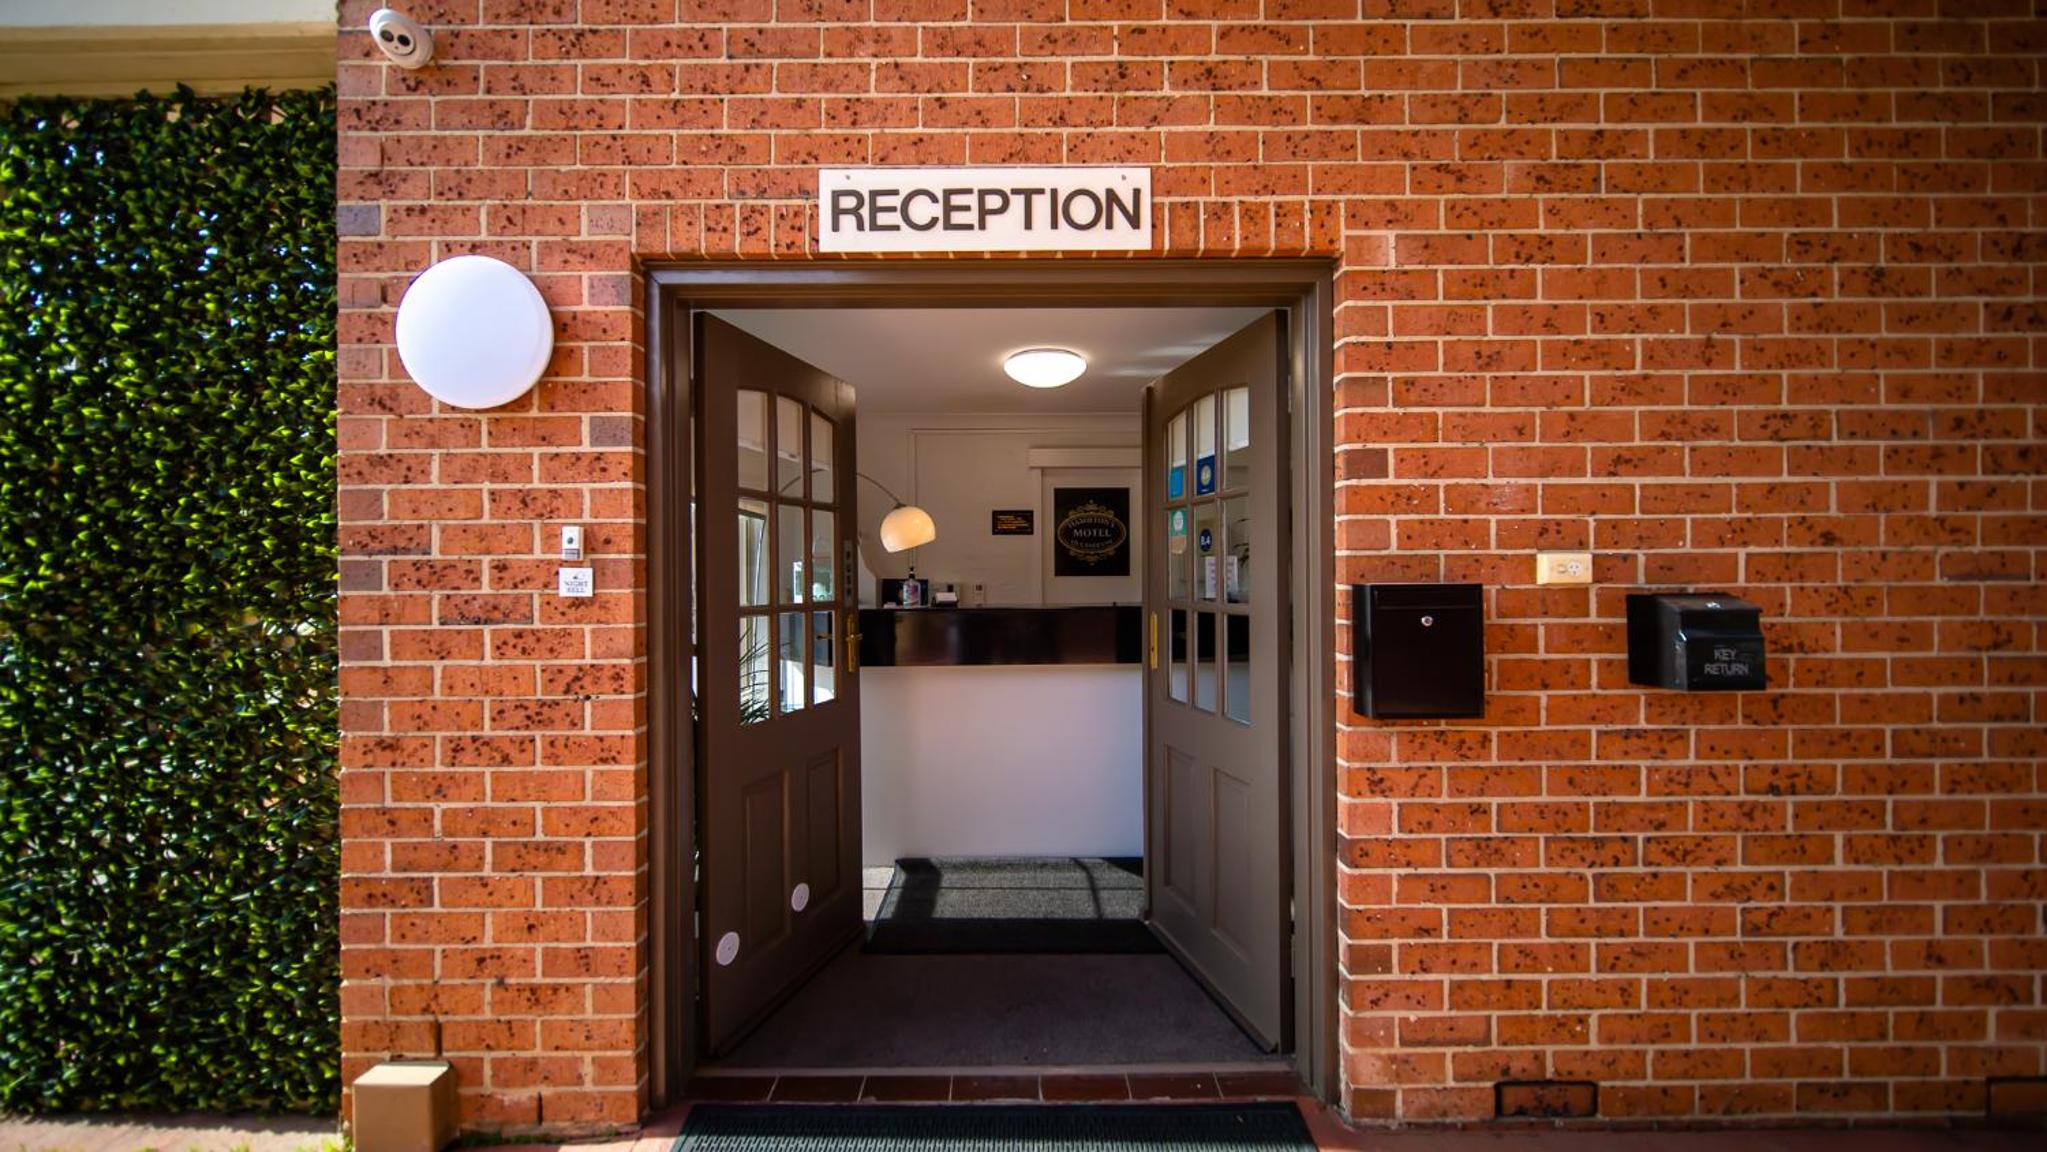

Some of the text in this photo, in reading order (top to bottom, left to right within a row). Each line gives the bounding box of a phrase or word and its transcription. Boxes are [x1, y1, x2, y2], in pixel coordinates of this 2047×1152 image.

[831, 188, 1142, 232] RECEPTION
[1073, 529, 1112, 538] MOTEL
[1714, 648, 1736, 661] KEY
[1704, 663, 1749, 676] RETURN
